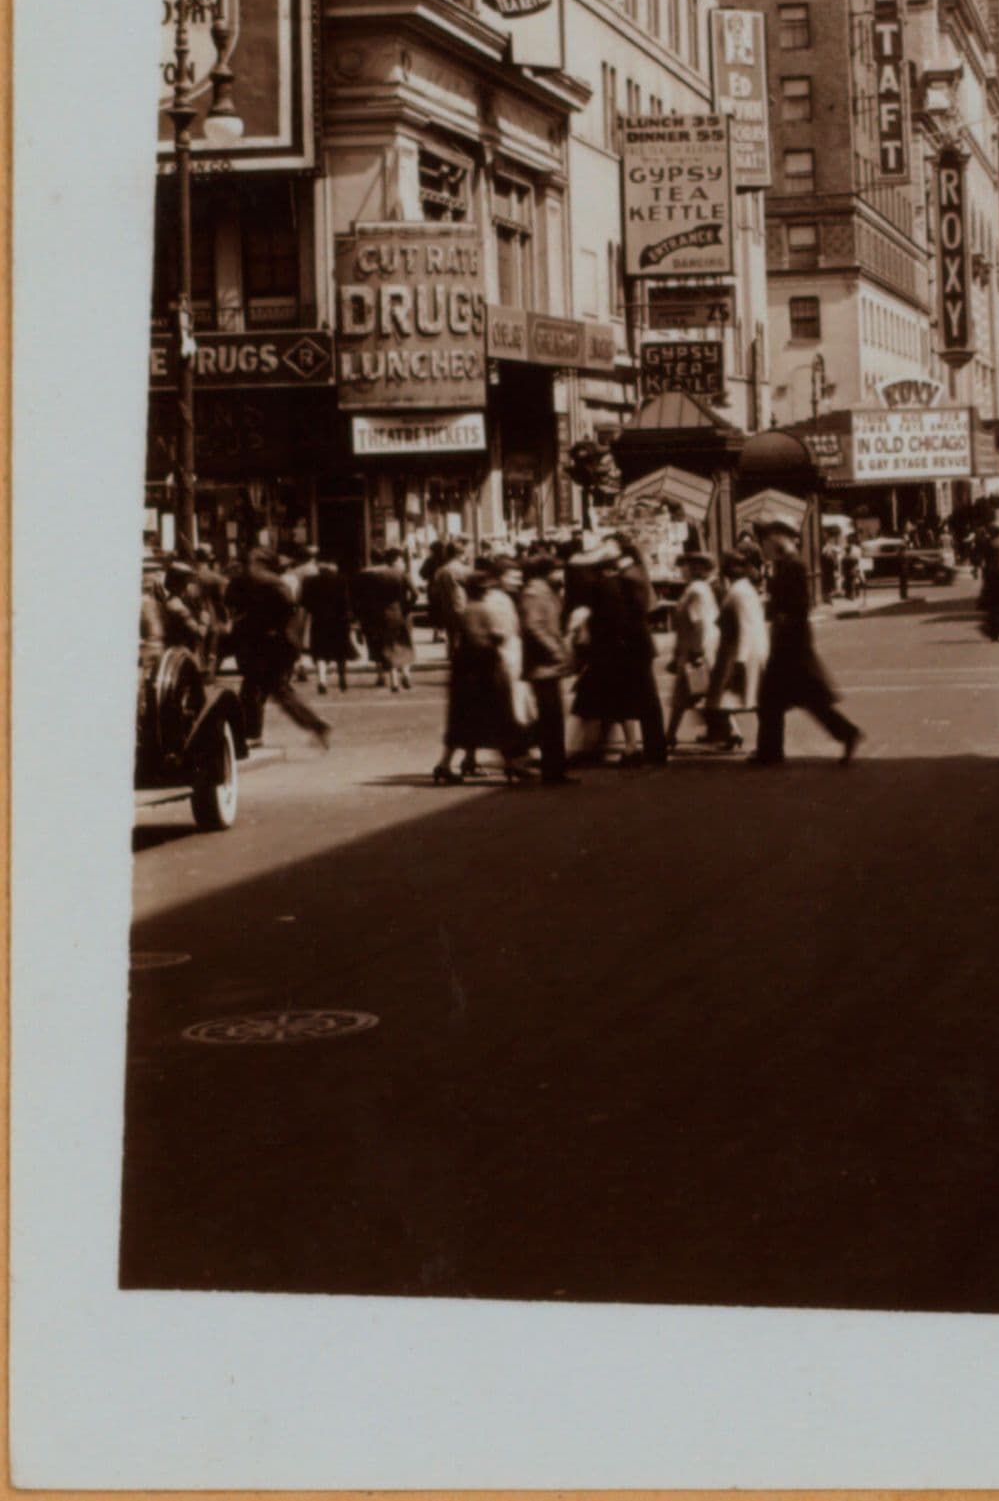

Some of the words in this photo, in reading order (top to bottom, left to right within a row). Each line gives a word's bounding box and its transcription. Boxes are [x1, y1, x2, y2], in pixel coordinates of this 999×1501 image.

[875, 23, 902, 171] TAFT
[626, 115, 684, 129] LUNCH
[626, 130, 690, 143] DINNER
[629, 165, 723, 184] GYPSY
[653, 186, 709, 202] TEA
[629, 203, 725, 221] KETTLE
[357, 244, 416, 276] CUT
[939, 168, 965, 339] ROXY
[340, 284, 486, 337] DRUGS
[192, 344, 279, 374] RUGS
[645, 345, 719, 365] GYPSY
[857, 437, 870, 454] IN
[875, 436, 904, 454] OLD
[908, 435, 968, 453] CHICAGO
[893, 457, 928, 470] STAGE
[933, 456, 969, 468] REVUE
